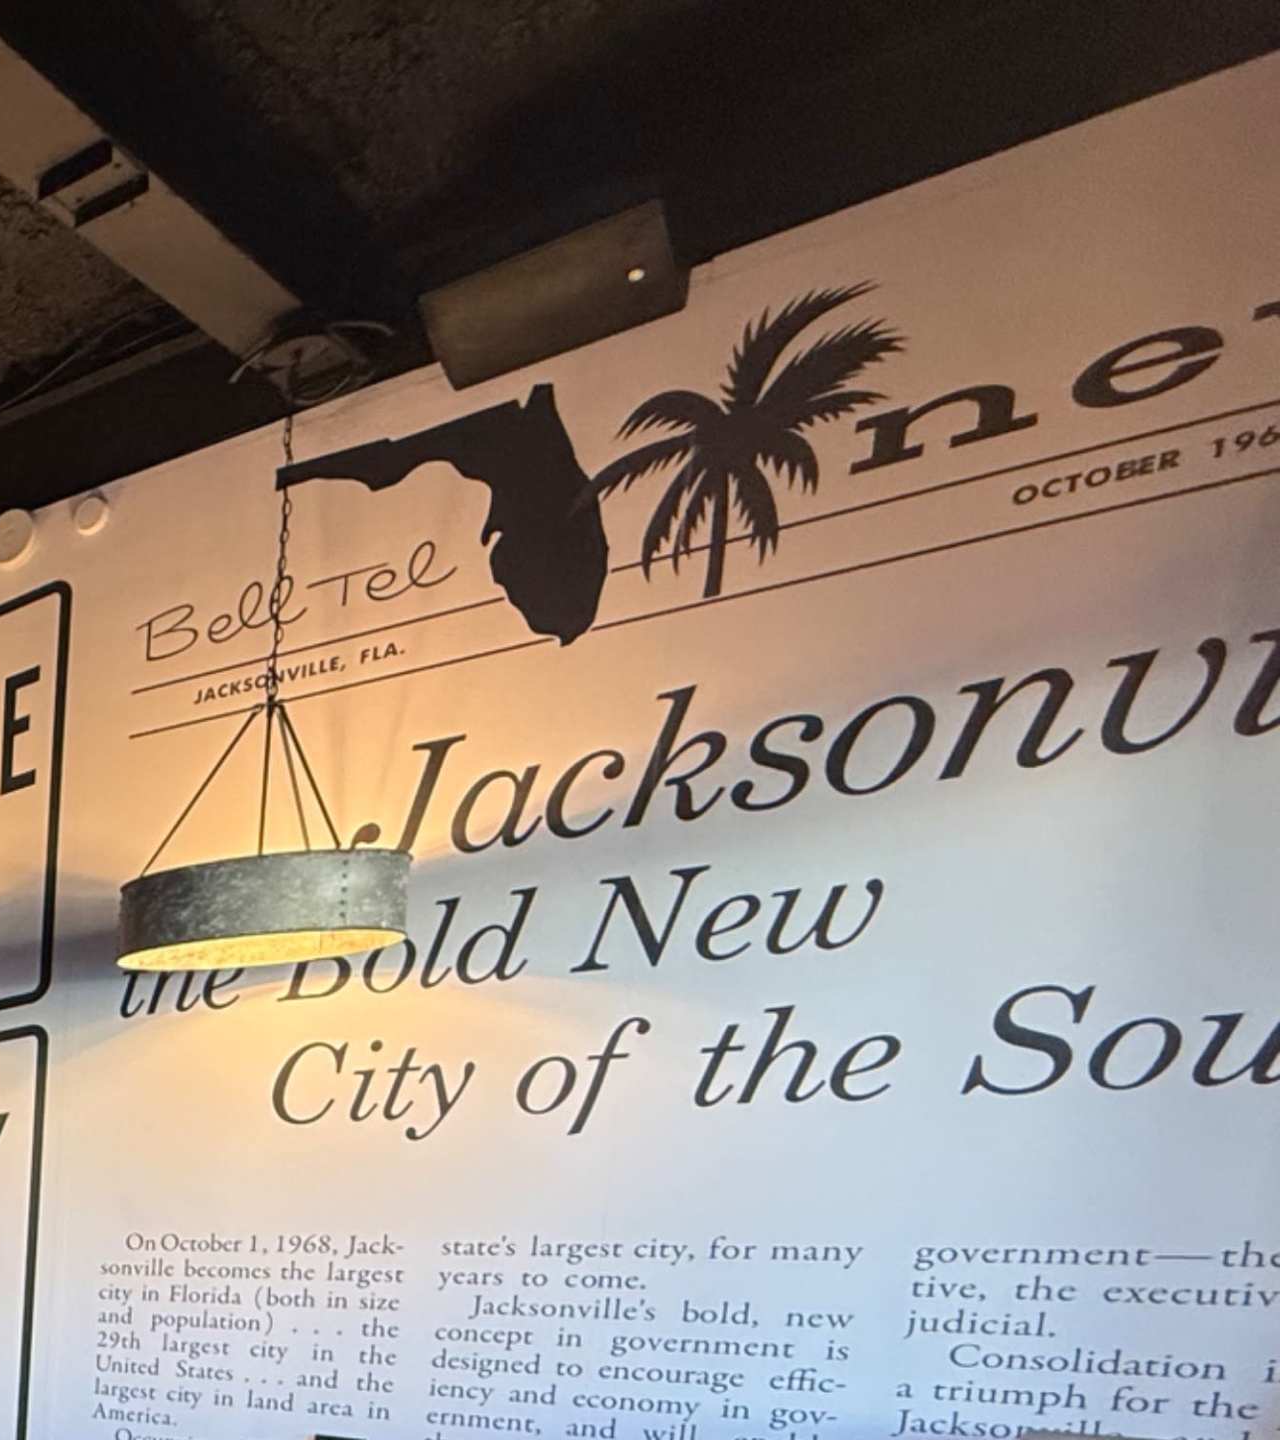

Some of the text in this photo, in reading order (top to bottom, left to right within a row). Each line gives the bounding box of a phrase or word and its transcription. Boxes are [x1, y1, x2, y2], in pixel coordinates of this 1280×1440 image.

[1012, 449, 1180, 506] OCTOBER
[135, 541, 458, 662] Bell Tel
[360, 642, 405, 665] FLA.
[572, 865, 884, 973] New
[272, 1040, 475, 1140] City
[517, 1017, 650, 1135] of
[692, 1006, 901, 1106] the
[126, 1232, 404, 1259] On October 1, 1968, Jack-
[442, 1235, 864, 1269] state's largest city, for many
[101, 1258, 271, 1279] sonville becomes
[438, 1269, 646, 1291] years come.
[169, 1284, 400, 1311] Florida (both size
[912, 1276, 987, 1301] tive,
[150, 1310, 274, 1336] population)
[468, 1294, 854, 1329] Jacksonville's bold, new
[904, 1308, 1056, 1339] judicial.
[97, 1330, 288, 1365] 29th city
[434, 1325, 849, 1361] concept government is
[96, 1354, 234, 1381] United States
[432, 1348, 846, 1394] designed encourage effic-
[949, 1344, 1226, 1380] Consolidation
[92, 1403, 177, 1426] America.
[94, 1377, 390, 1420] largest city in land area in
[429, 1380, 837, 1431] iency economy gov-
[933, 1383, 1086, 1415] triumph
[426, 1411, 542, 1437] ernment,
